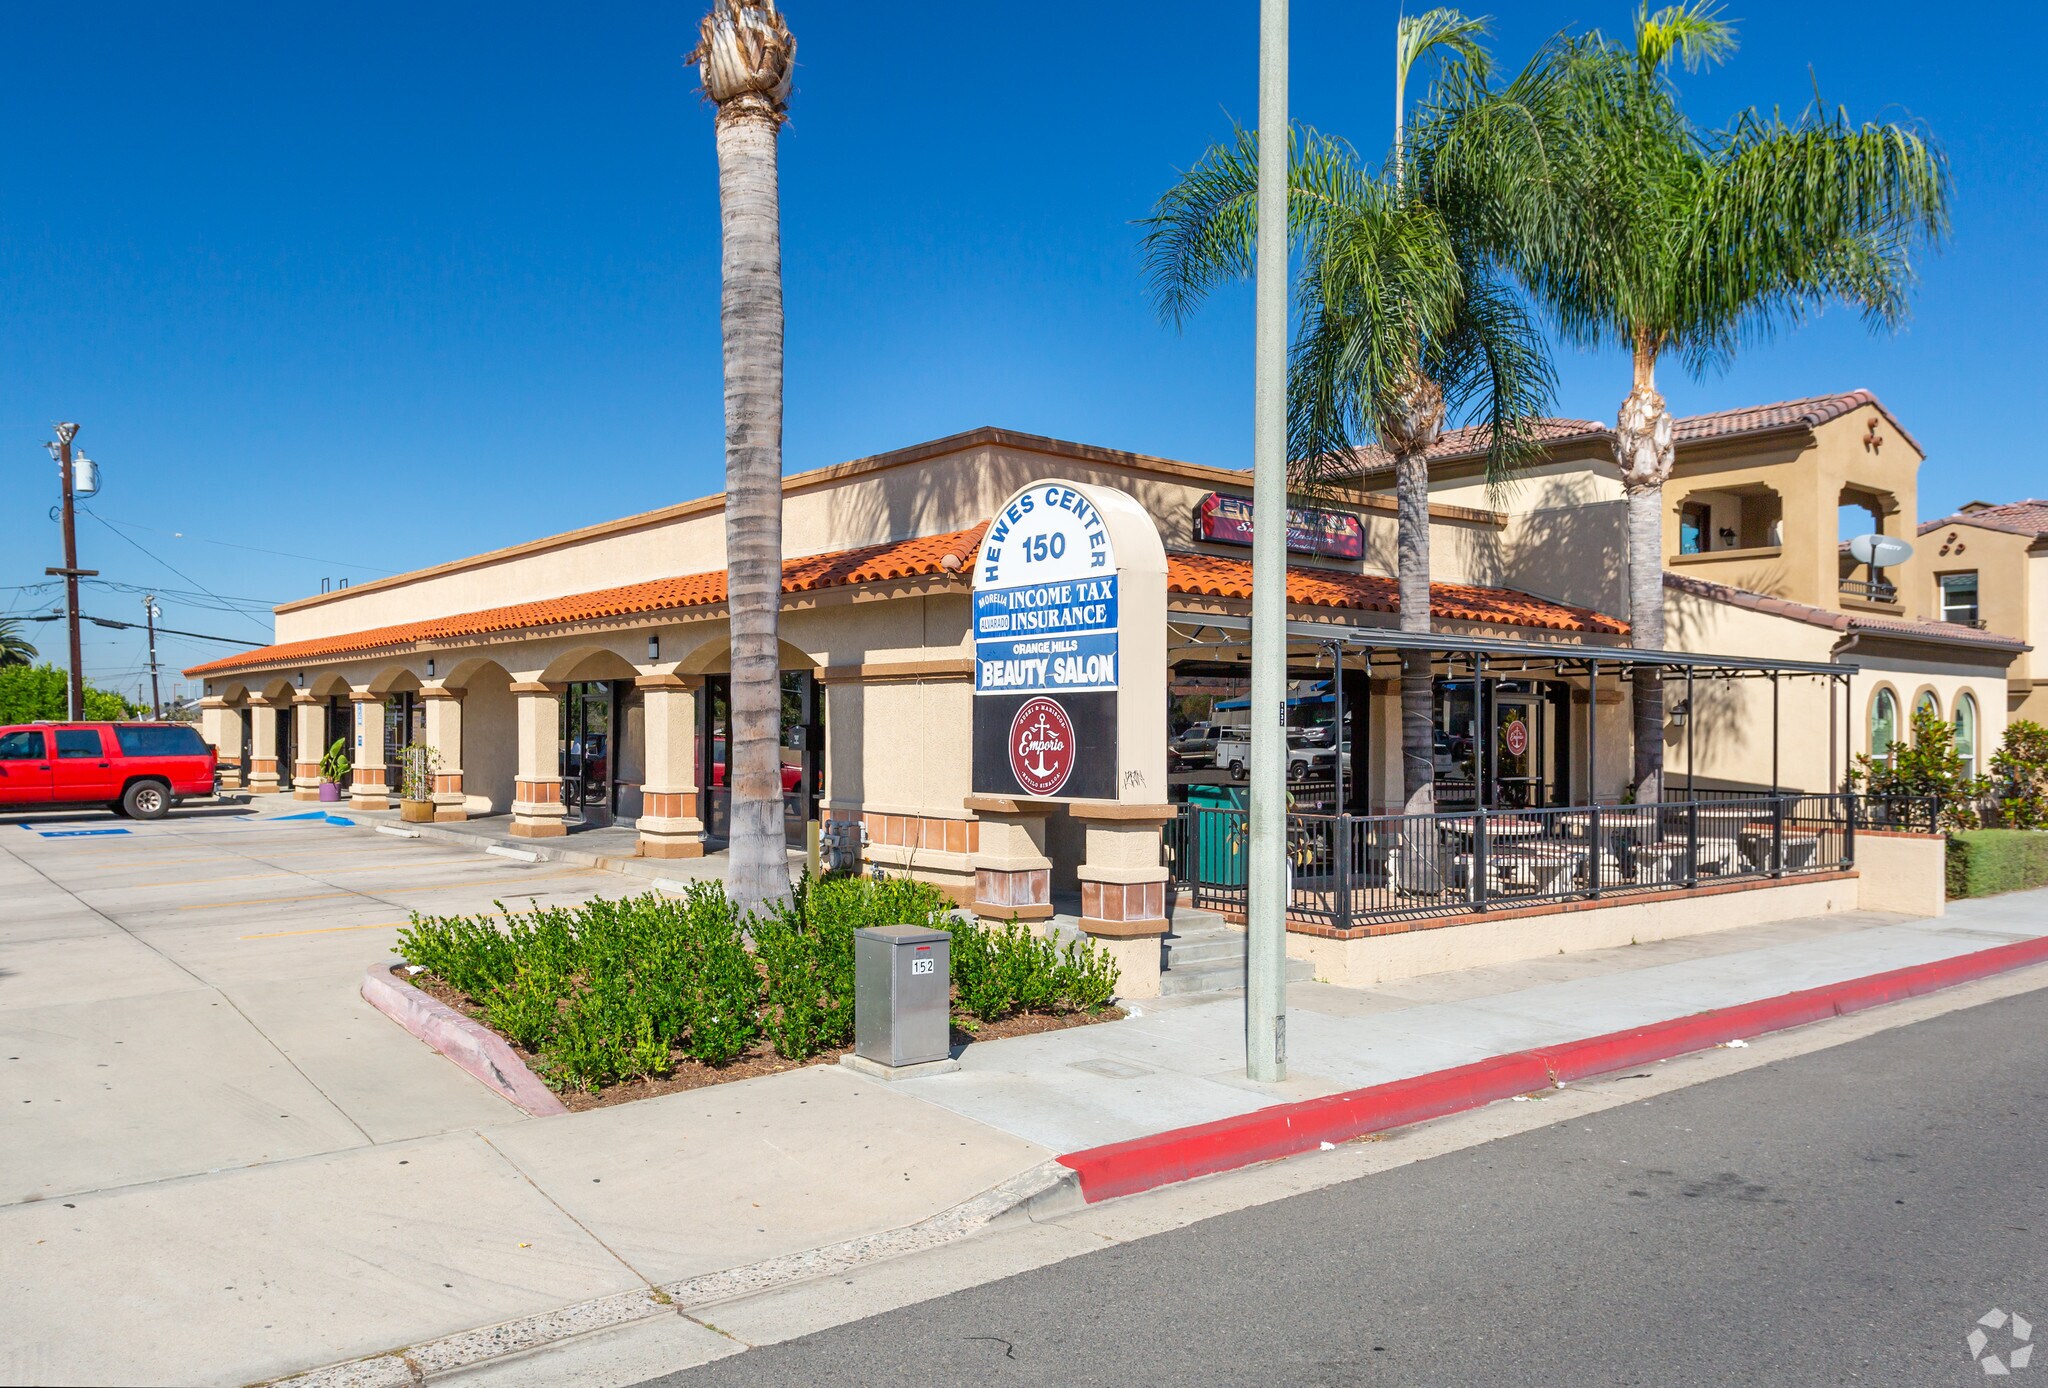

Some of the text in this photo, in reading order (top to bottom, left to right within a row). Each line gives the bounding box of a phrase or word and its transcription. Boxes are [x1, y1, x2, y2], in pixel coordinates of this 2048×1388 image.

[985, 488, 1106, 582] HEWES CENTER
[1022, 532, 1066, 563] 150
[978, 593, 1008, 609] MORELIA
[1008, 580, 1113, 610] INCOME TAX
[980, 616, 1009, 630] ALVARADO
[1011, 604, 1107, 631] INSURANCE
[1012, 640, 1078, 655] ORANGE HILLS
[983, 654, 1114, 687] BEAUTY SALON
[1018, 730, 1064, 757] Emporio
[914, 960, 933, 973] 152
